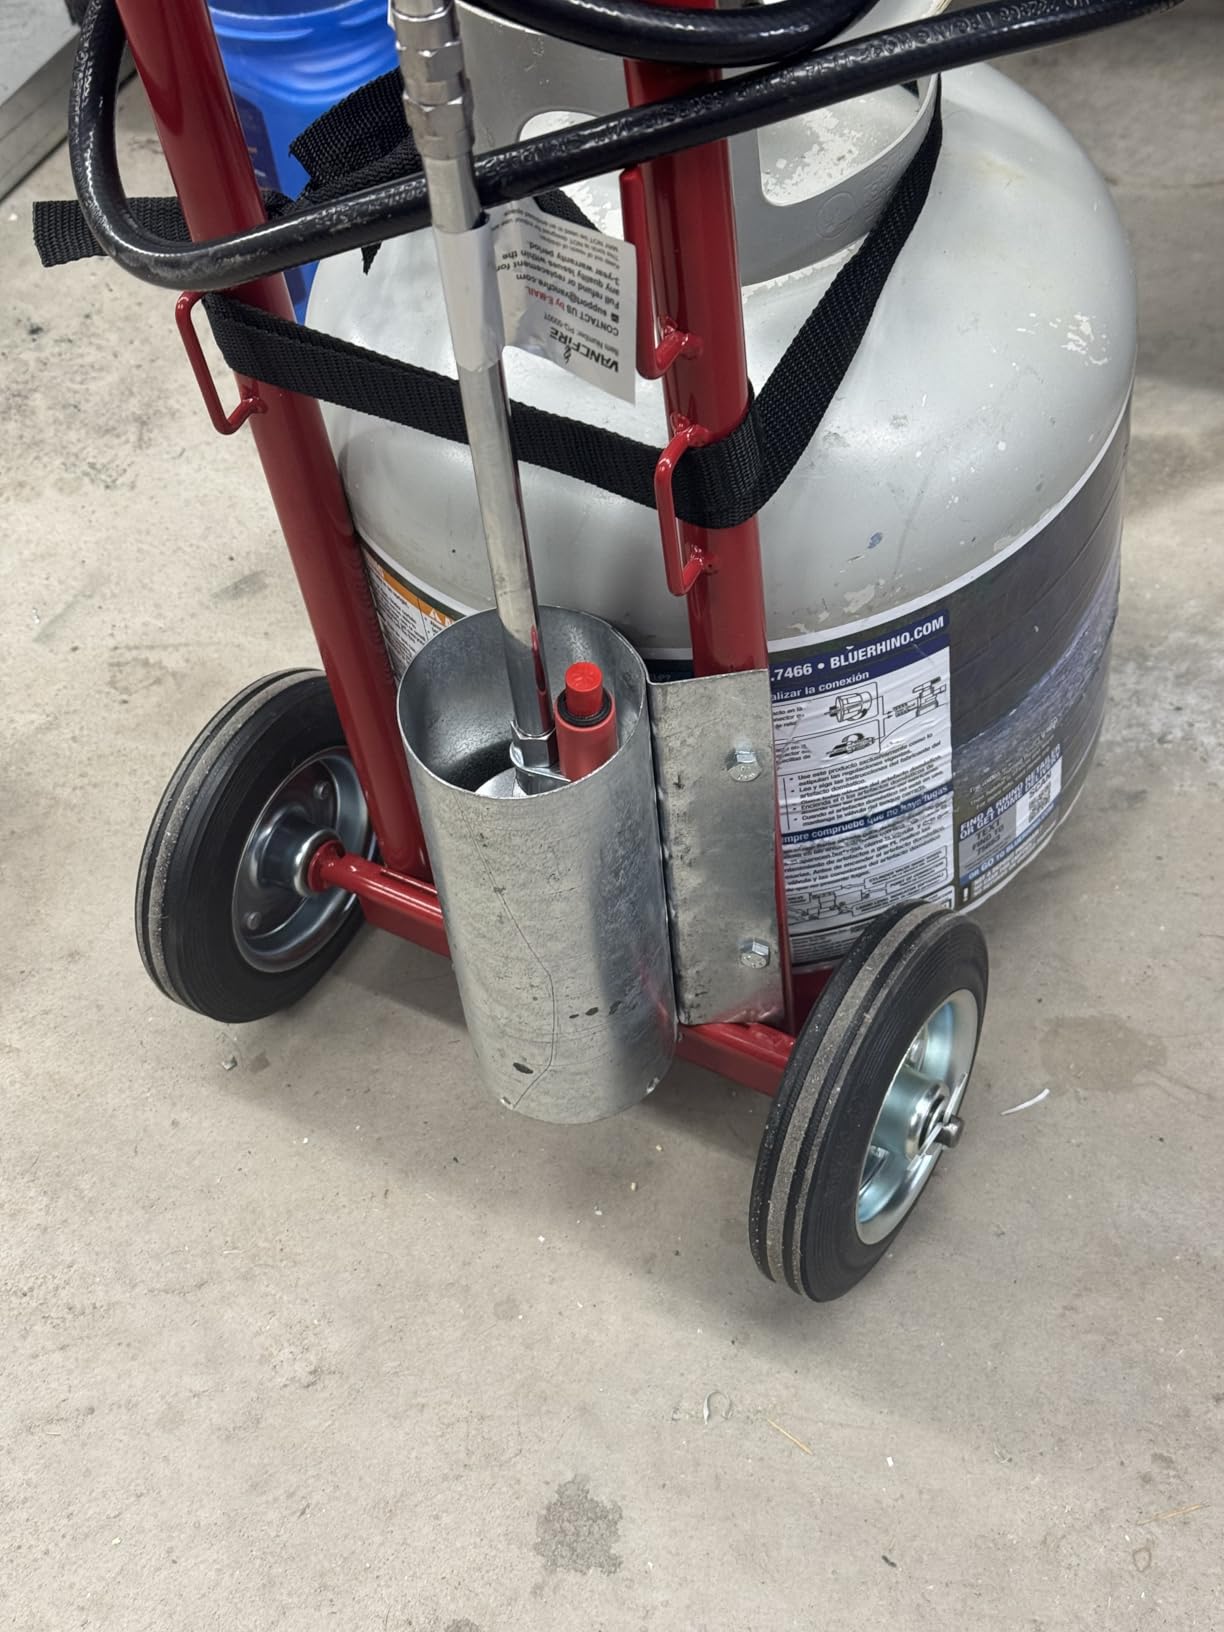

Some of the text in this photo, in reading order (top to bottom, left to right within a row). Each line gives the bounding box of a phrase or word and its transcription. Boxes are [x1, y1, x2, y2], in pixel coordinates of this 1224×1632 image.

[502, 249, 619, 296] any quality issues within the
[556, 252, 592, 273] warranty
[495, 258, 619, 308] Full refund or replacement for
[525, 285, 552, 304] E-MAIL
[555, 298, 564, 310] by
[566, 305, 577, 316] US
[580, 312, 618, 336] CONTACT
[550, 327, 619, 373] VANCFIRE
[830, 615, 944, 669] BLUERHINO.COM
[805, 685, 815, 694] la
[819, 672, 869, 690] conexión
[828, 761, 857, 774] producto
[1029, 770, 1051, 798] SCAN
[801, 811, 826, 820] Cuando
[960, 825, 973, 840] OR
[977, 810, 994, 829] GET
[997, 789, 1022, 814] HOME
[960, 812, 983, 832] FIND
[986, 804, 992, 815] A
[812, 819, 865, 839] compruebe
[976, 817, 999, 841] TEXT
[981, 856, 993, 872] GO
